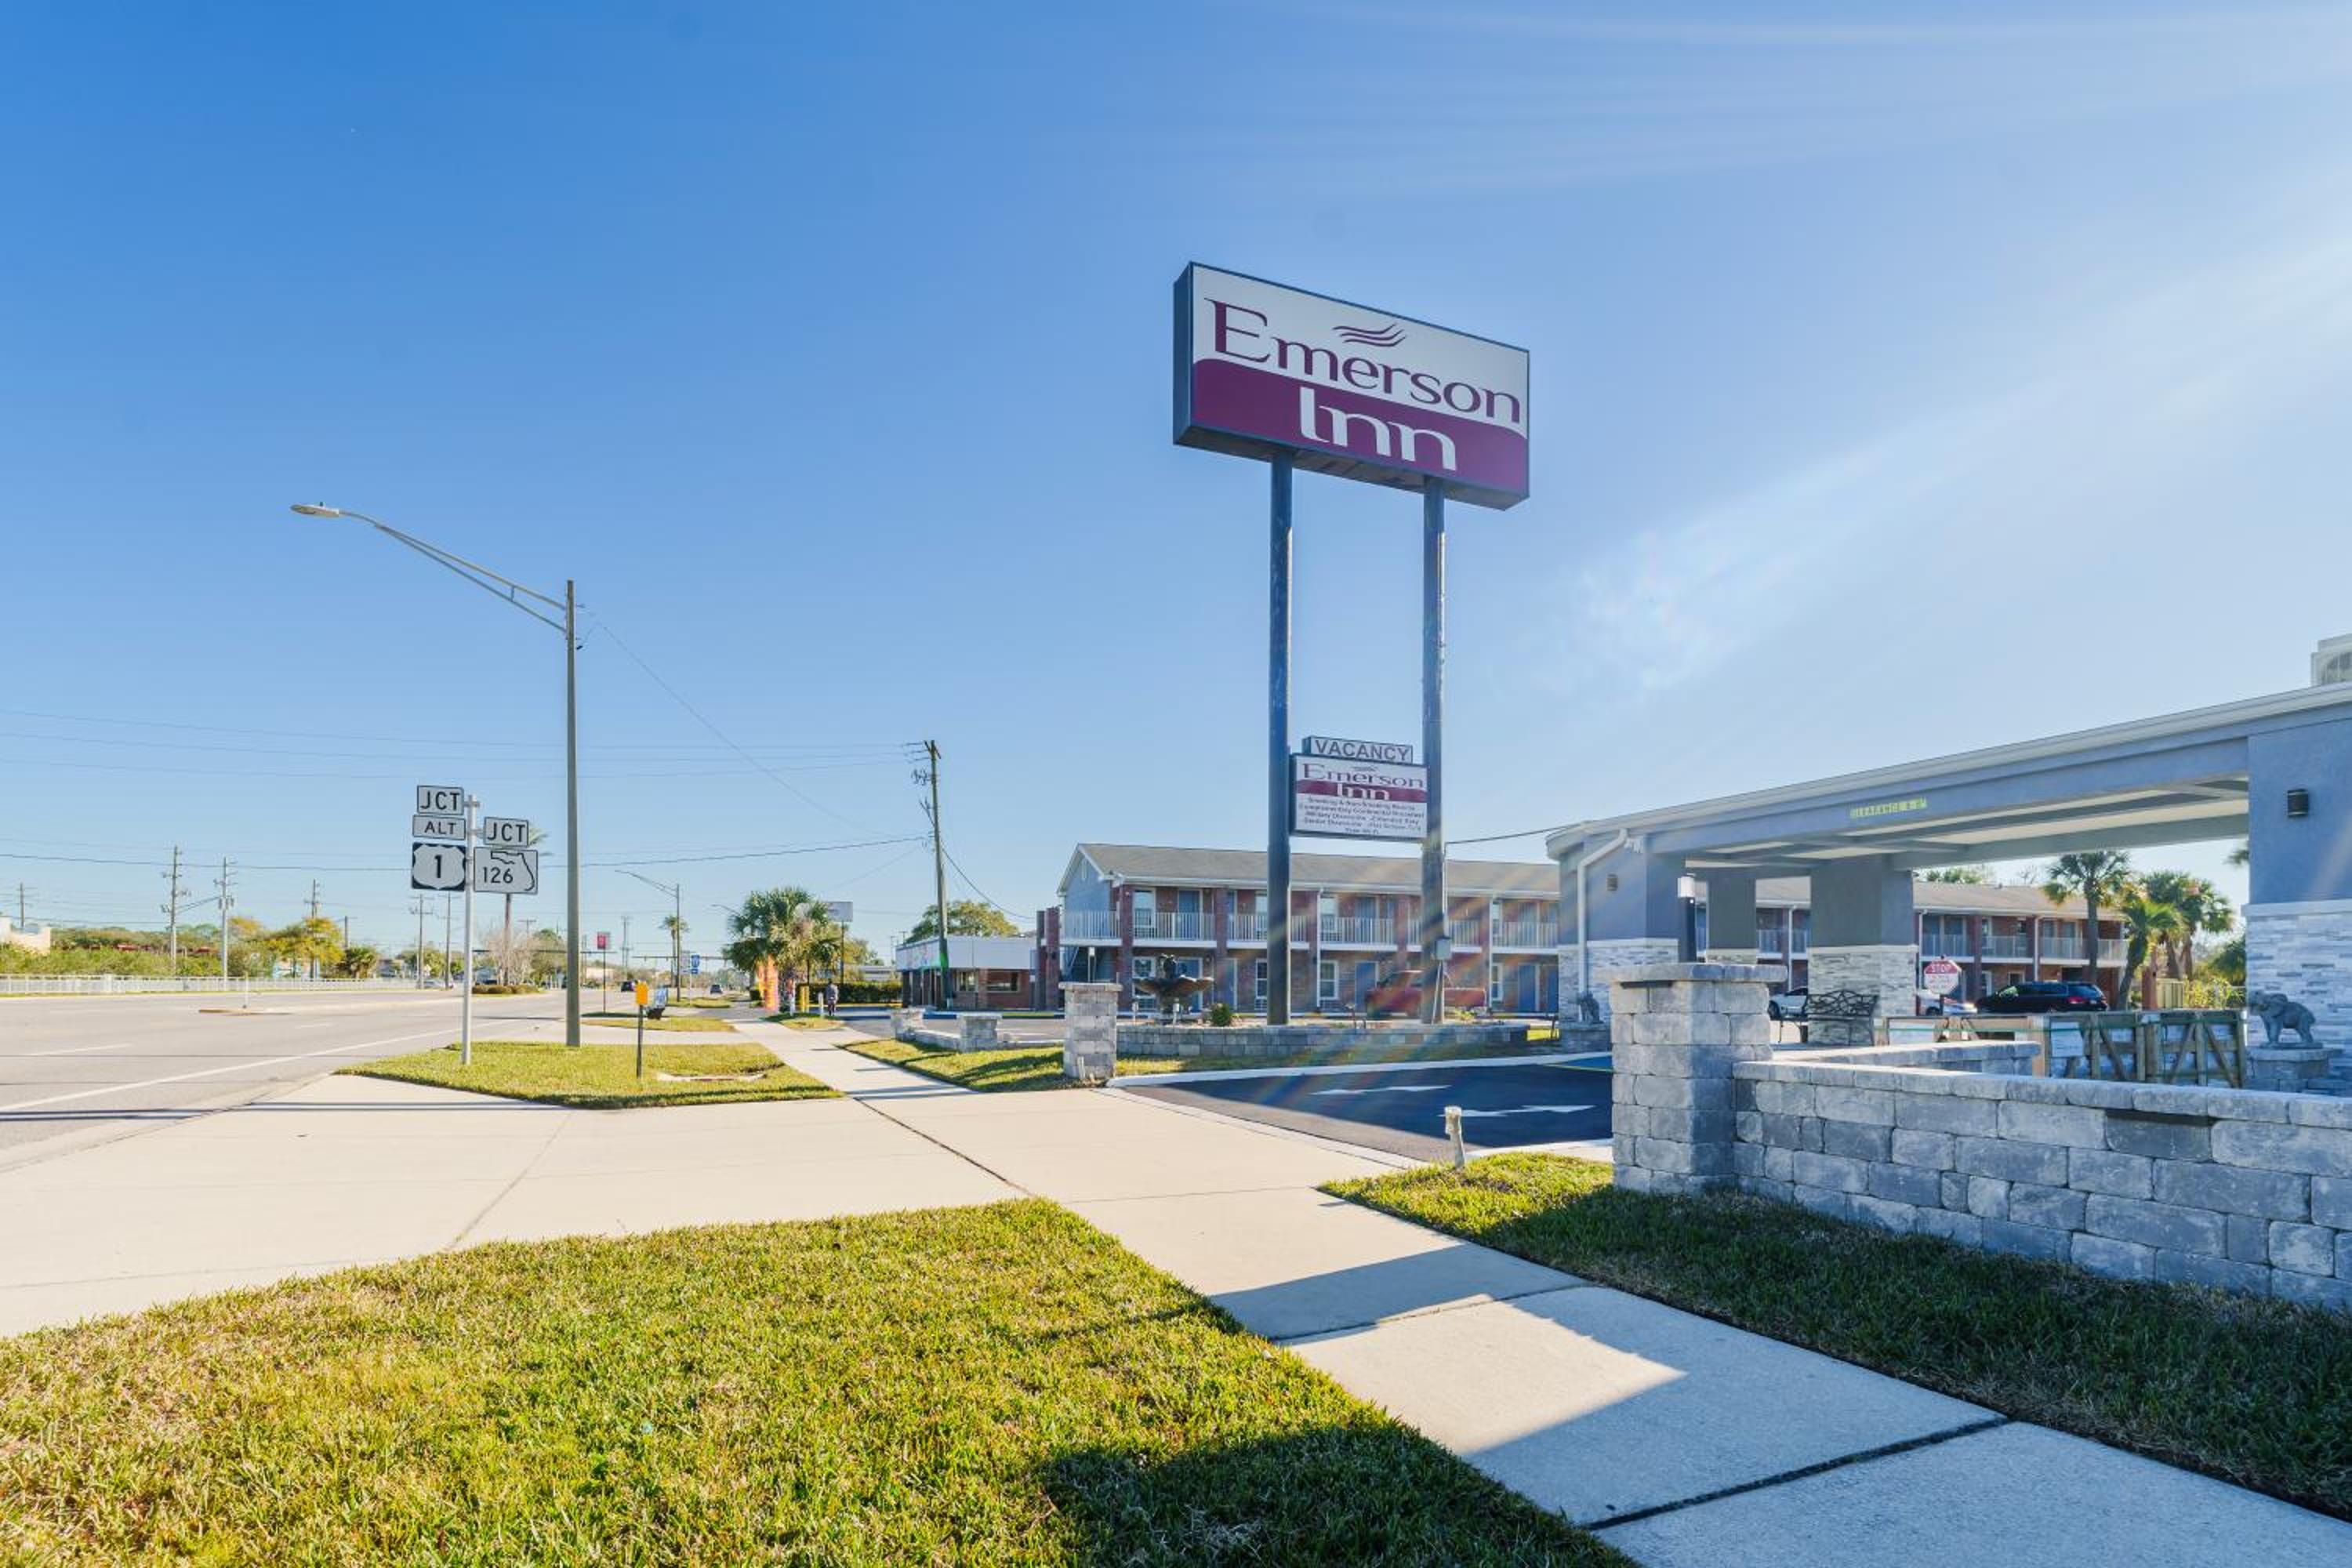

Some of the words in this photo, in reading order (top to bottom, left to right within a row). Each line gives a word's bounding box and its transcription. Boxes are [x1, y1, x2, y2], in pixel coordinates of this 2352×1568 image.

[1203, 297, 1520, 424] Emerson
[1299, 386, 1457, 471] Inn
[1316, 739, 1410, 761] VACANCY
[1302, 763, 1423, 788] Emerson
[420, 791, 460, 811] JCT
[1337, 782, 1391, 800] Inn
[424, 821, 456, 835] ALT
[487, 822, 526, 843] JCT
[434, 855, 442, 879] 1
[483, 866, 514, 884] 126
